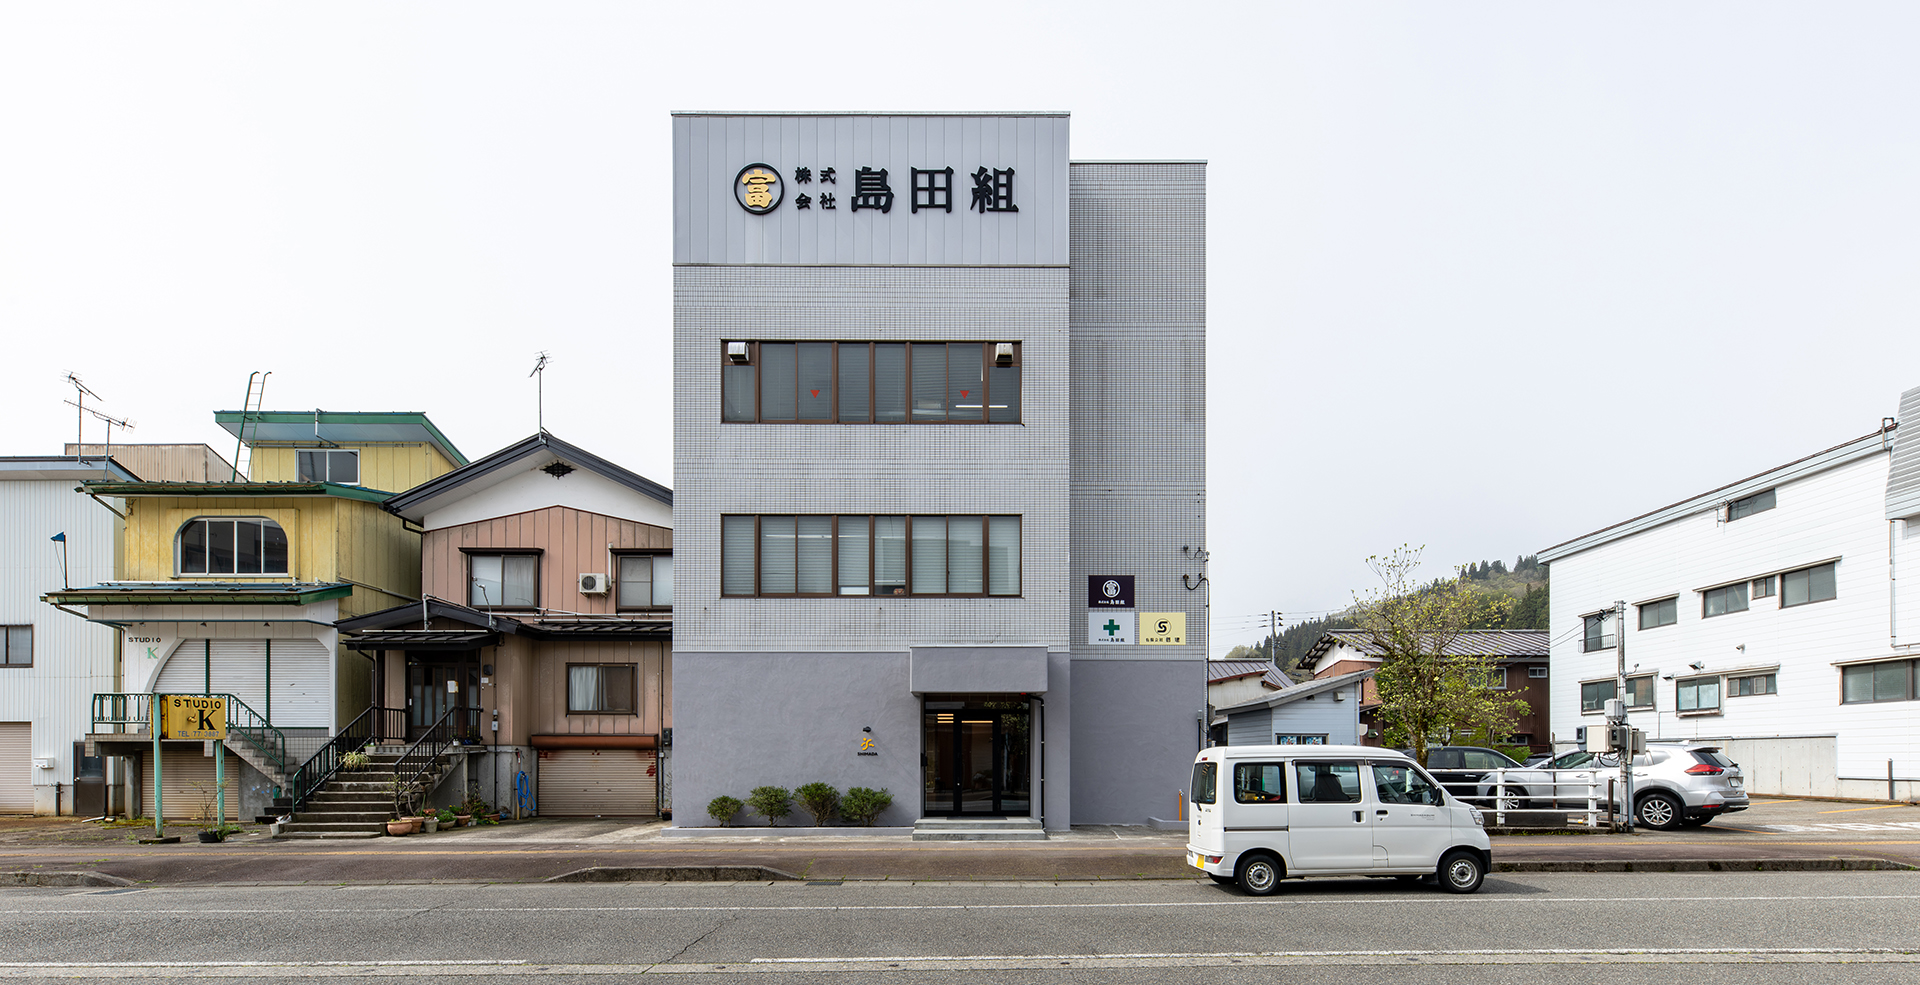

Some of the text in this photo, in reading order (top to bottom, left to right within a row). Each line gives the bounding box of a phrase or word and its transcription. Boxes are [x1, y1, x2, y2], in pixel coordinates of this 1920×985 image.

[795, 166, 836, 184] 株式
[851, 166, 1019, 213] 島田組
[795, 192, 836, 210] 会社
[147, 647, 158, 659] K
[173, 698, 221, 709] STUDIO
[197, 709, 217, 730] K
